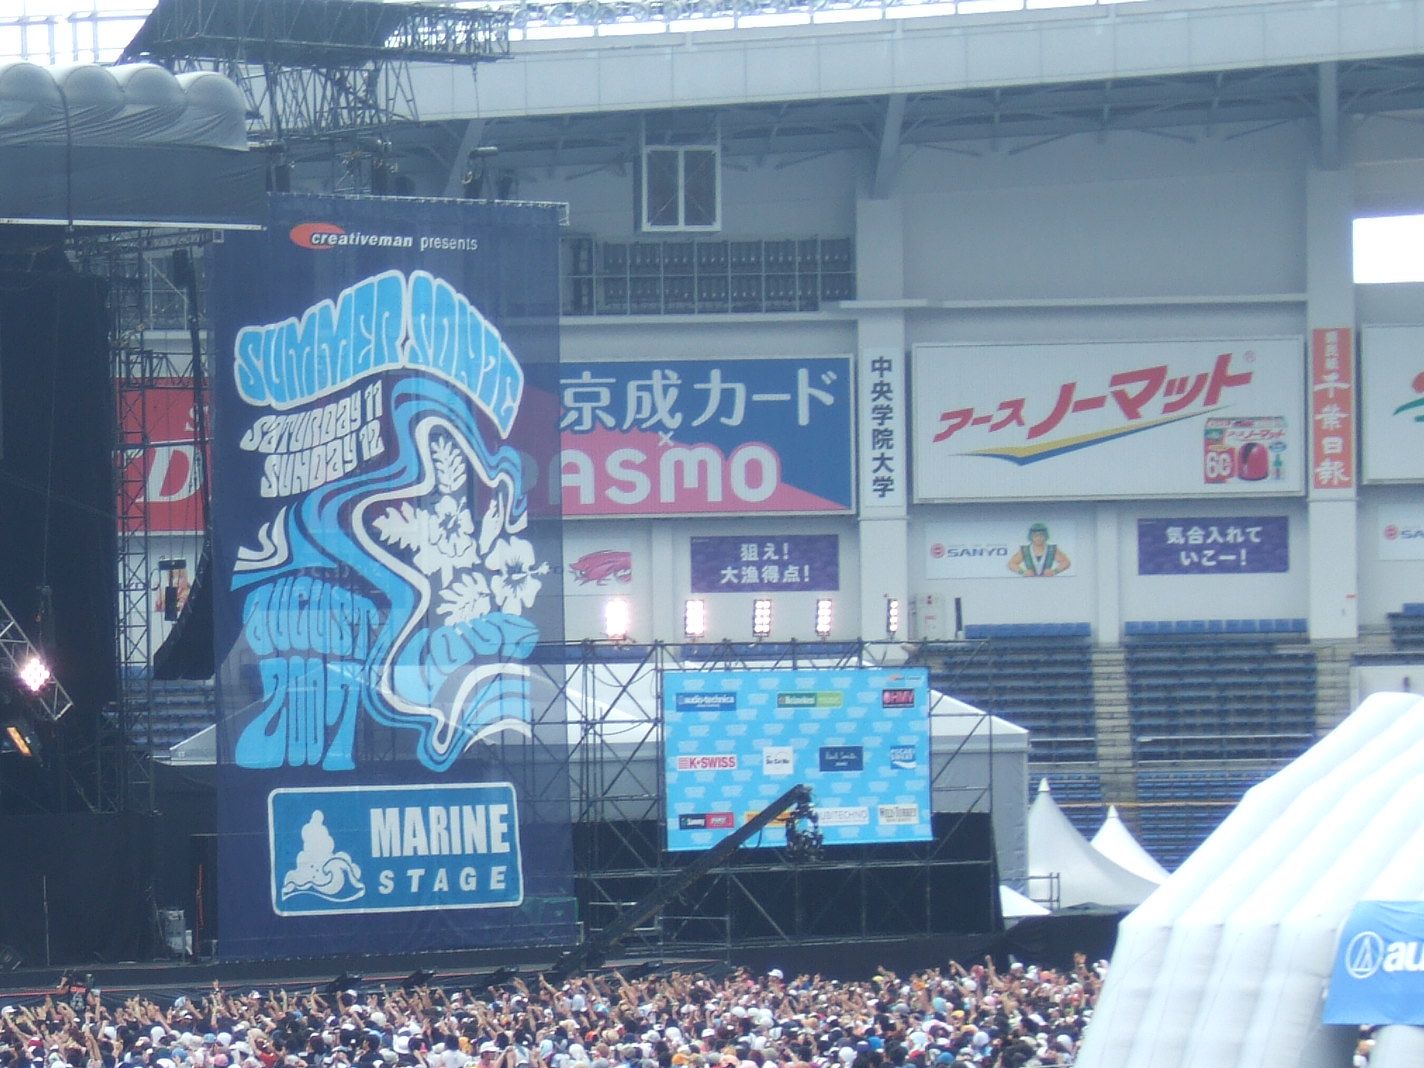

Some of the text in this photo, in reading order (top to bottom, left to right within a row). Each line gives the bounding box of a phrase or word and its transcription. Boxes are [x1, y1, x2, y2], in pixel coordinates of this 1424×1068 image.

[311, 230, 478, 251] creativeman presents
[234, 269, 406, 411] SUMMER
[239, 390, 362, 453] SATURDAY
[559, 366, 840, 431] 京成カード
[870, 355, 895, 499] 中央学院大学
[260, 437, 358, 498] SUNDAY
[740, 542, 790, 562] 狙え!
[947, 547, 1008, 558] SANYO
[1165, 525, 1264, 545] 気合入れて
[1179, 549, 1248, 567] いこー!
[719, 565, 811, 585] 大漁得点!
[243, 576, 381, 660] AUGUST
[234, 655, 365, 771] 2007
[370, 804, 511, 858] MARINE
[379, 866, 508, 895] STAGE
